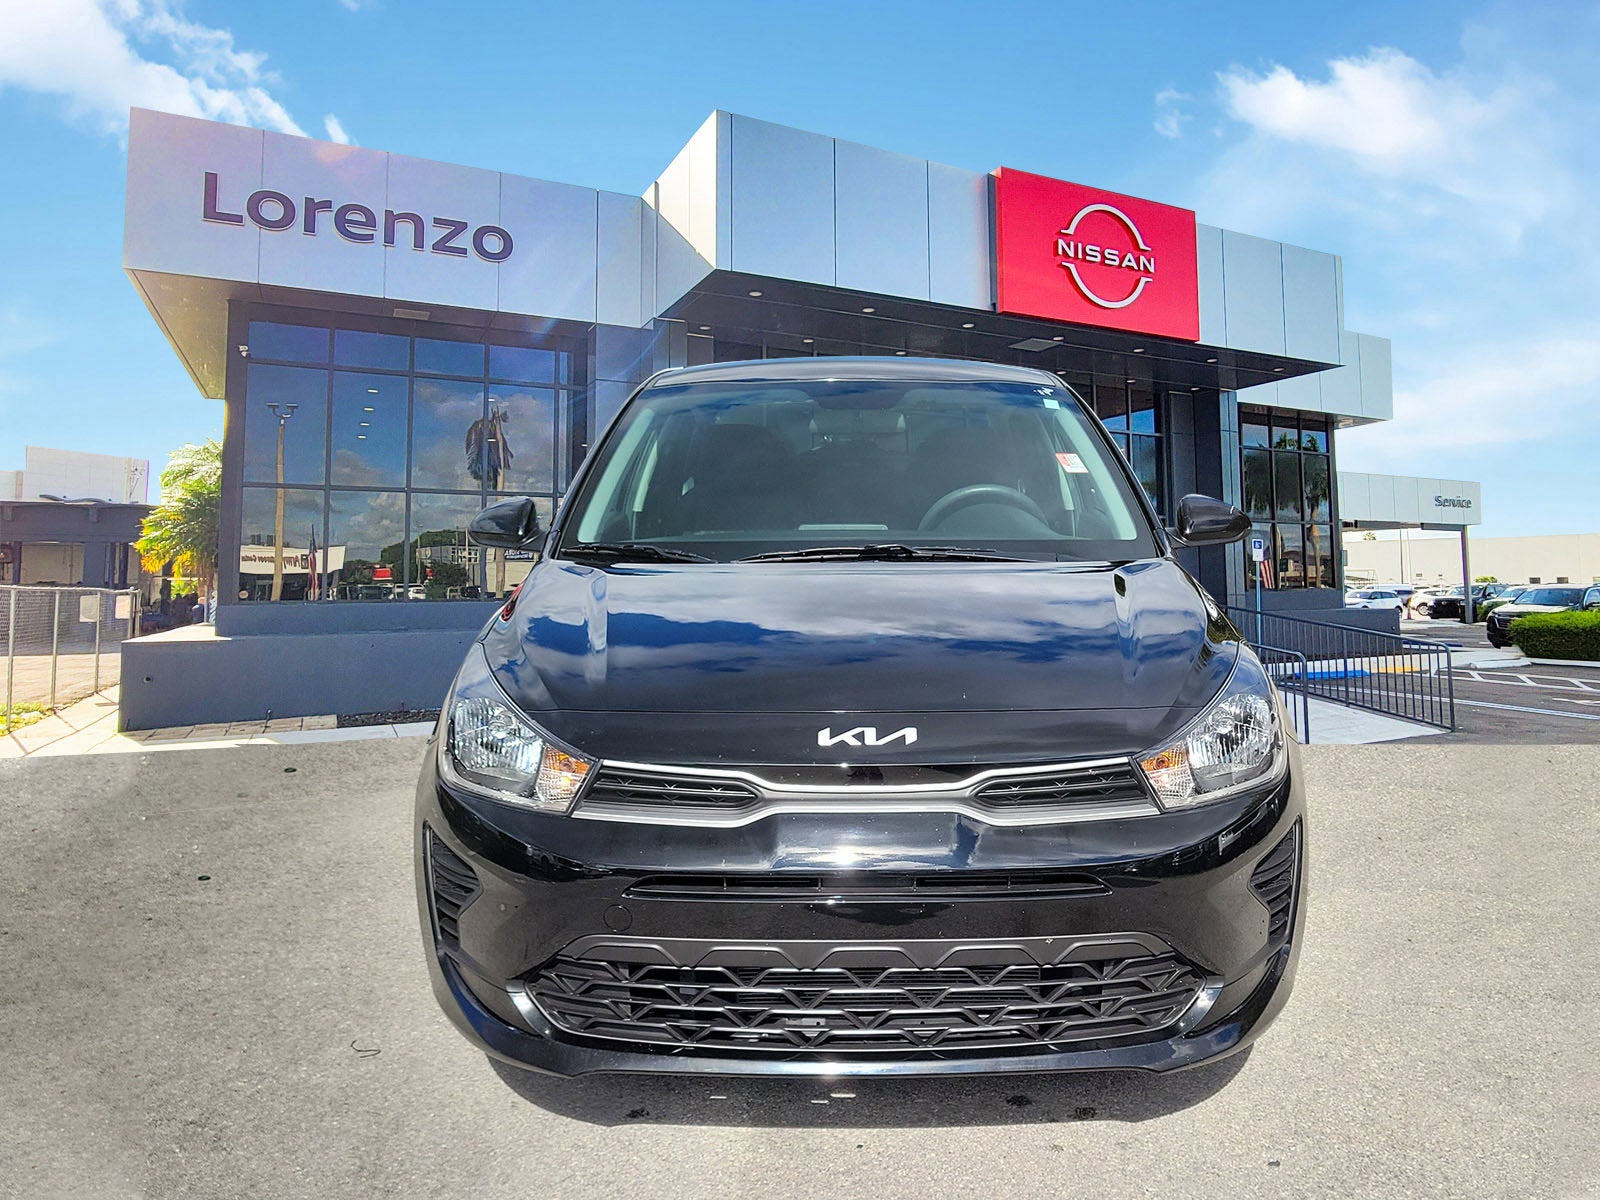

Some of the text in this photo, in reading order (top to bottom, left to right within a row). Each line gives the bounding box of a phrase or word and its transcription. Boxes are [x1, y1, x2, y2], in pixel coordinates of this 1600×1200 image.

[203, 171, 515, 261] Lorenzo
[1057, 238, 1155, 273] NISSAN
[1434, 495, 1472, 509] Service
